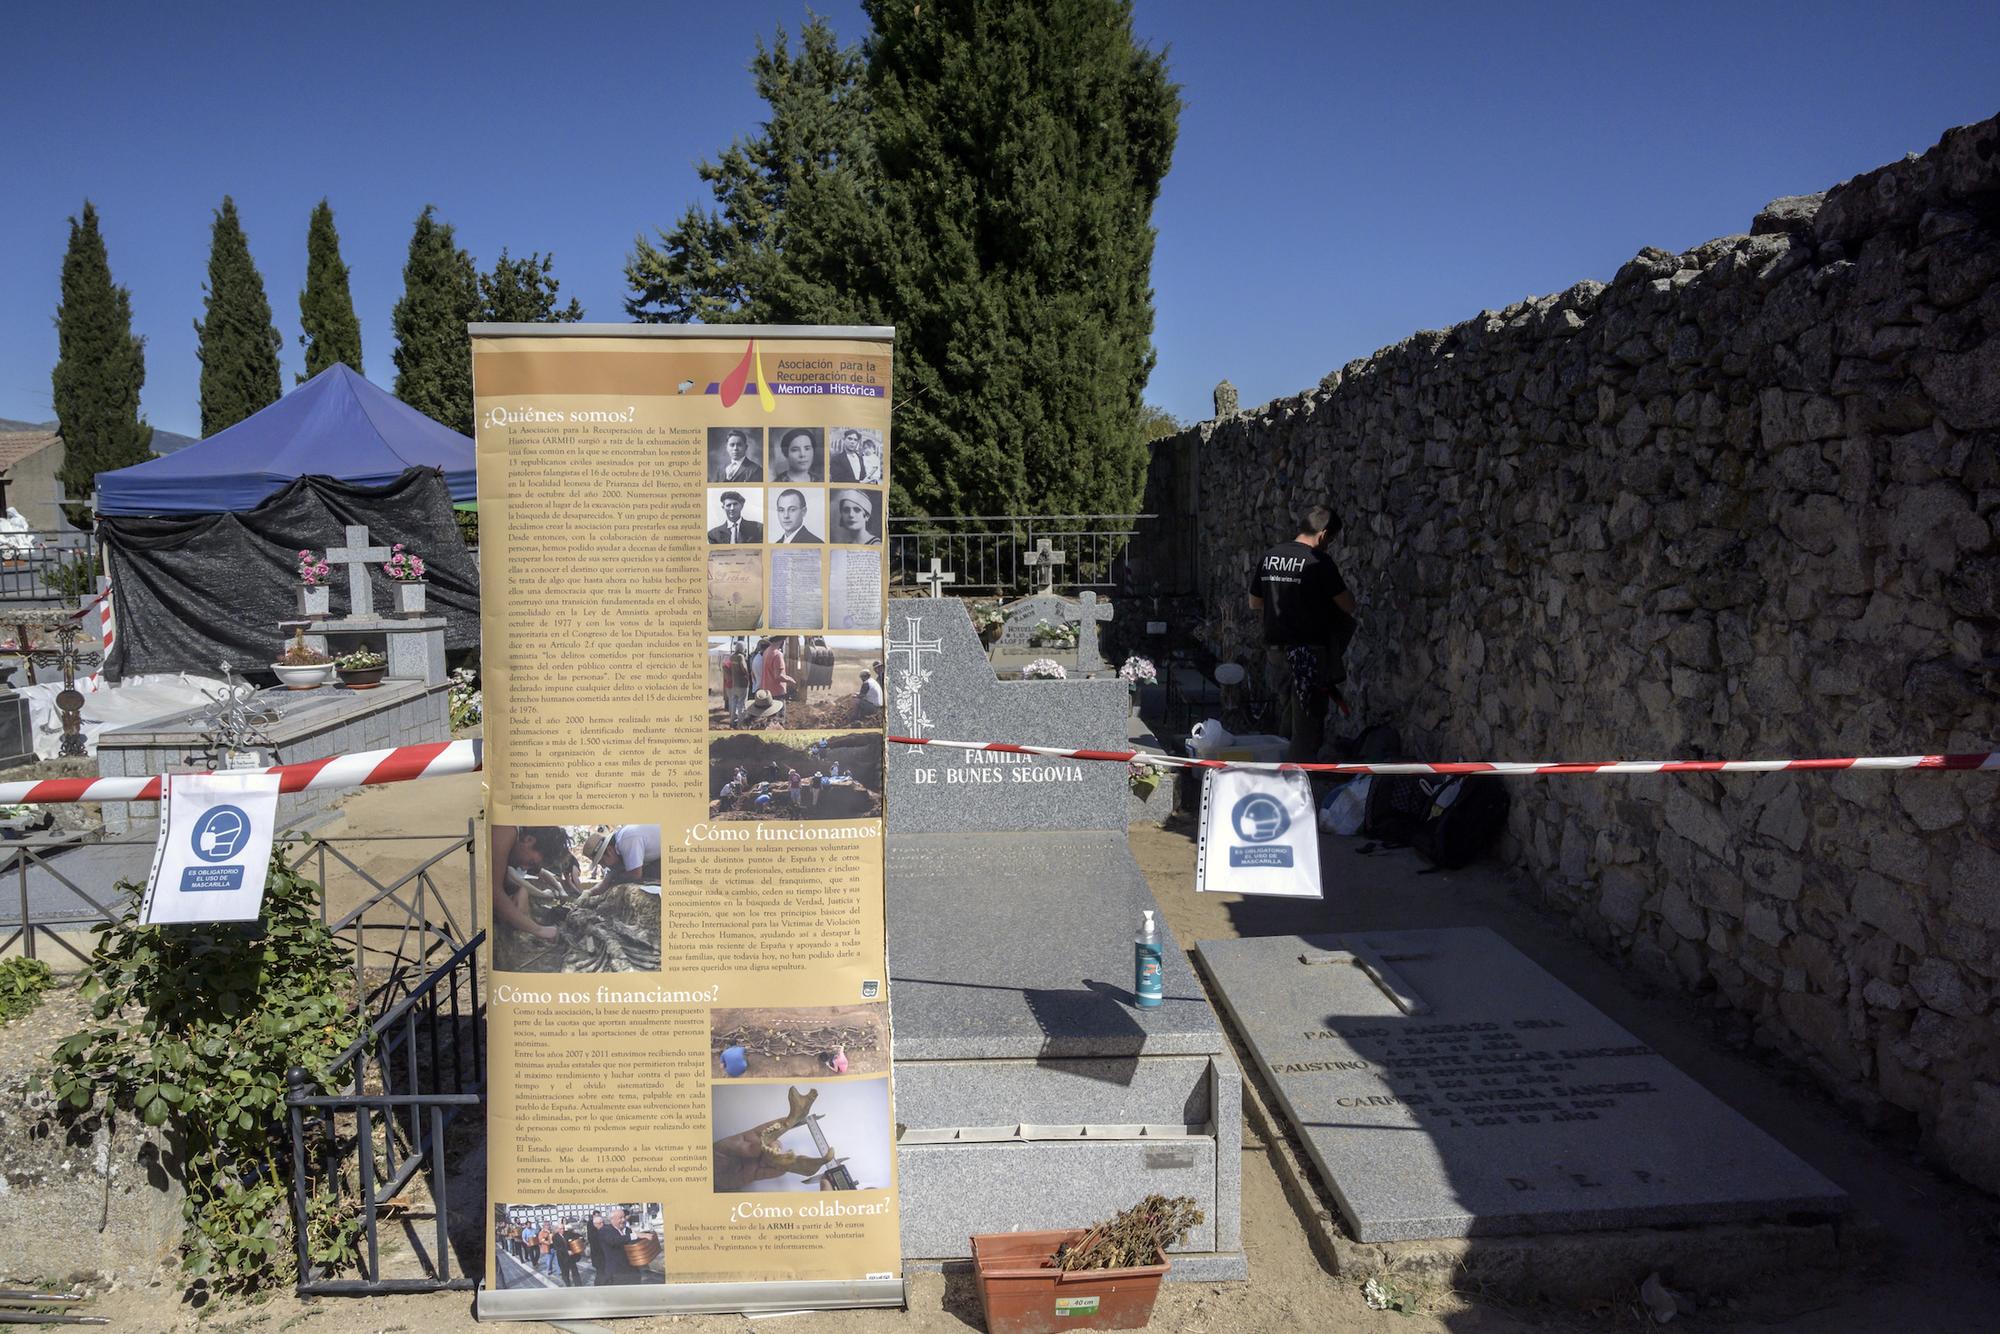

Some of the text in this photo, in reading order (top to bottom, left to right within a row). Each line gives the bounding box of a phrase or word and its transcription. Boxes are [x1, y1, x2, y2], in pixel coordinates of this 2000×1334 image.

[778, 359, 875, 370] Asociación para la
[777, 371, 875, 383] Recuperación de la
[778, 384, 875, 396] Memoria Histórica
[484, 407, 635, 429] ¿Quiénes somos?
[507, 426, 701, 436] La Asociación para la Recuperación de la Memoria
[510, 458, 517, 466] 13
[521, 458, 567, 468] republicanos
[570, 458, 592, 466] civiles
[596, 458, 634, 466] asesinados
[638, 460, 651, 468] por
[668, 460, 689, 468] grupo
[692, 458, 701, 466] de
[525, 490, 534, 499] de
[537, 490, 565, 499] octubre
[569, 490, 580, 498] del
[584, 490, 598, 498] año
[627, 490, 667, 498] Numerosas
[671, 492, 701, 500] personas
[1263, 556, 1305, 572] ARMH
[508, 587, 524, 595] ellos
[544, 587, 586, 595] democracia
[590, 589, 605, 597] que
[625, 586, 631, 594] la
[664, 586, 674, 594] de
[678, 586, 702, 594] Franco
[510, 715, 703, 725] Desde el año 2000 hemos realizado más de 150
[966, 749, 1032, 763] FAMILIA
[915, 767, 1083, 783] DE BUNES SEGOVIA
[685, 820, 882, 846] ¿Cómo funcionamos?
[669, 843, 860, 854] Estas exhumaciones las realizan personas voluntarias
[715, 912, 729, 920] que
[750, 909, 760, 917] los
[781, 908, 817, 919] principios
[821, 908, 846, 916] básicos
[849, 907, 860, 916] del
[669, 918, 860, 930] Derecho Internacional para las Víctimas de Violación
[493, 985, 718, 1005] ¿Cómo nos financiamos?
[515, 1050, 534, 1058] Entre
[535, 1050, 545, 1058] los
[547, 1050, 564, 1058] años
[566, 1050, 583, 1058] 2007
[591, 1050, 608, 1058] 2011
[611, 1049, 646, 1058] estuvimos
[648, 1049, 686, 1057] recibiendo
[1271, 1061, 1369, 1074] FAUSTINO
[1336, 1094, 1433, 1107] CARMEN
[560, 1155, 574, 1163] Más
[580, 1154, 589, 1163] de
[598, 1154, 626, 1162] 113.000
[633, 1156, 663, 1164] personas
[670, 1153, 707, 1162] continúan
[730, 1197, 890, 1222] ¿Cómo colaborar?
[675, 1223, 699, 1231] Puedes
[701, 1223, 726, 1231] hacerte
[728, 1222, 747, 1231] socio
[748, 1222, 757, 1230] de
[759, 1222, 765, 1230] la
[767, 1222, 794, 1230] ARMH
[802, 1221, 822, 1232] partir
[823, 1221, 833, 1229] de
[835, 1221, 844, 1229] 36
